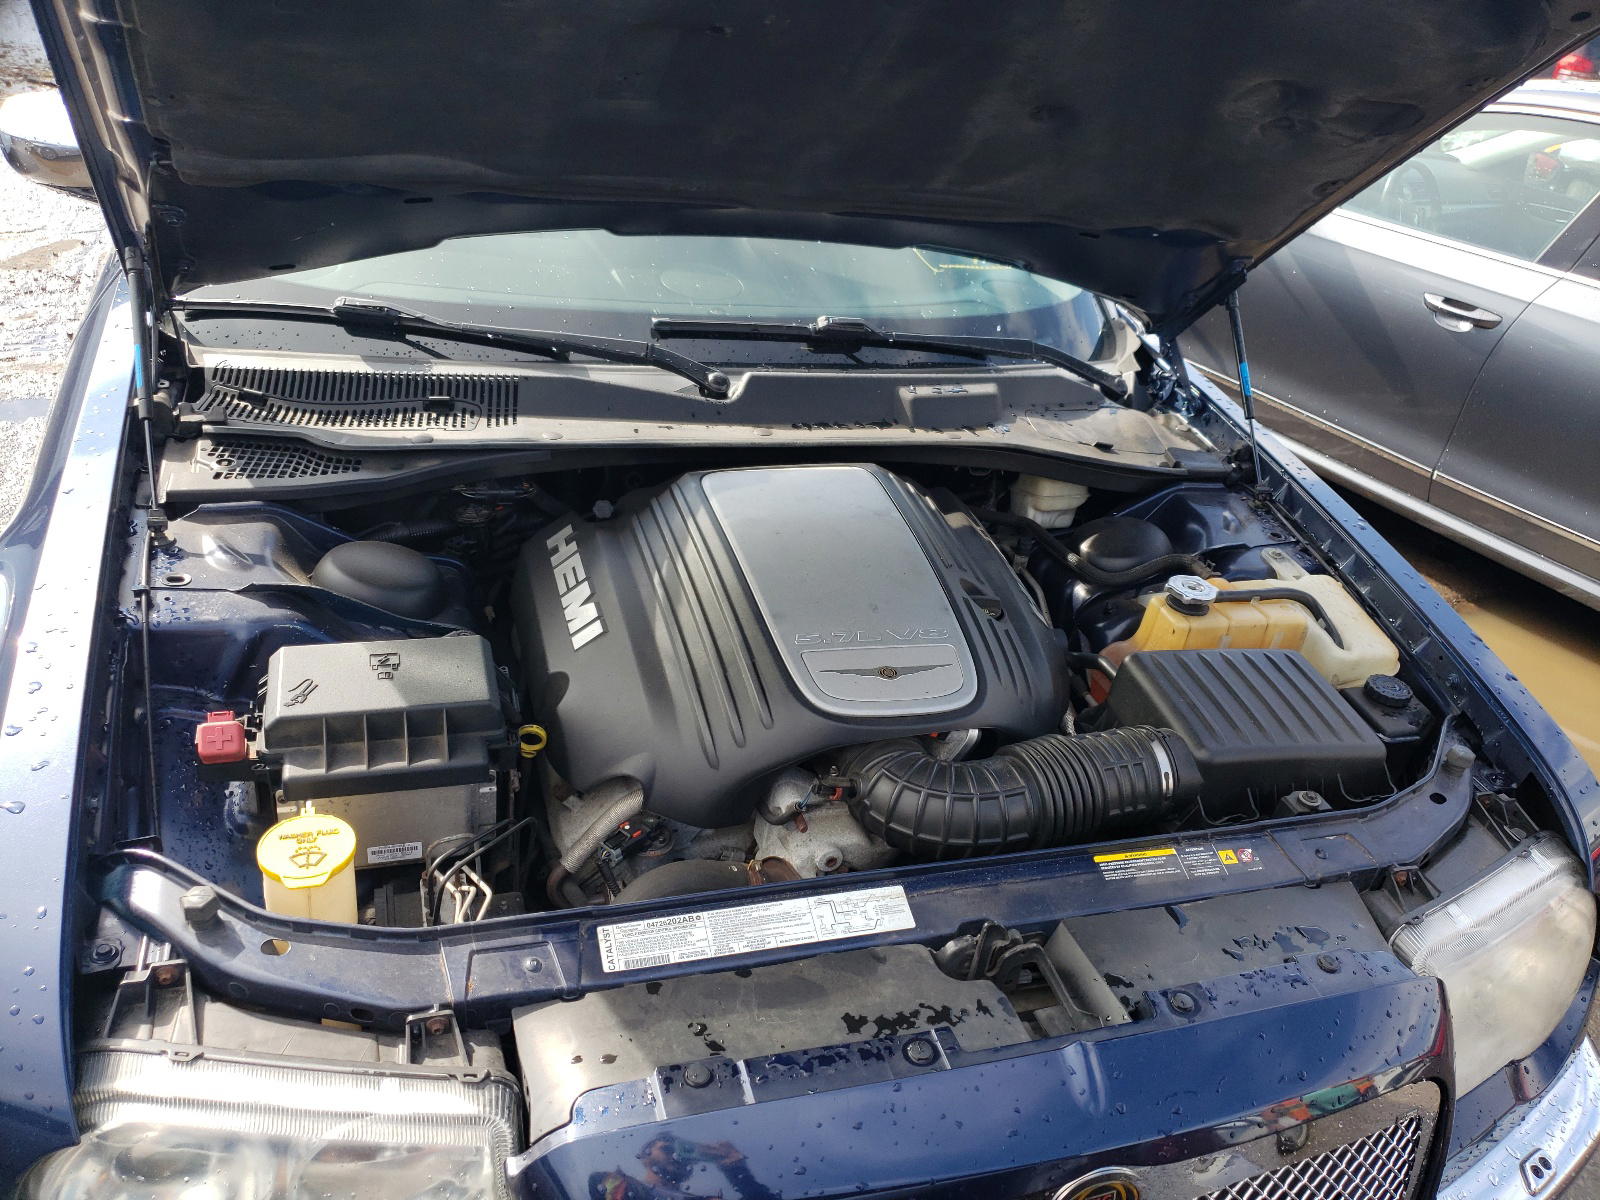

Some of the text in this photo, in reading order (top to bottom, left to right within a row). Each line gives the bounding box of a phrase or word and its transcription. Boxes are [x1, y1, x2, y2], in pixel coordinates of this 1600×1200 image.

[546, 524, 604, 650] HEMI
[794, 627, 950, 645] 5.7L V8
[279, 828, 340, 840] WASHER FLUID
[602, 928, 616, 971] CATALYST
